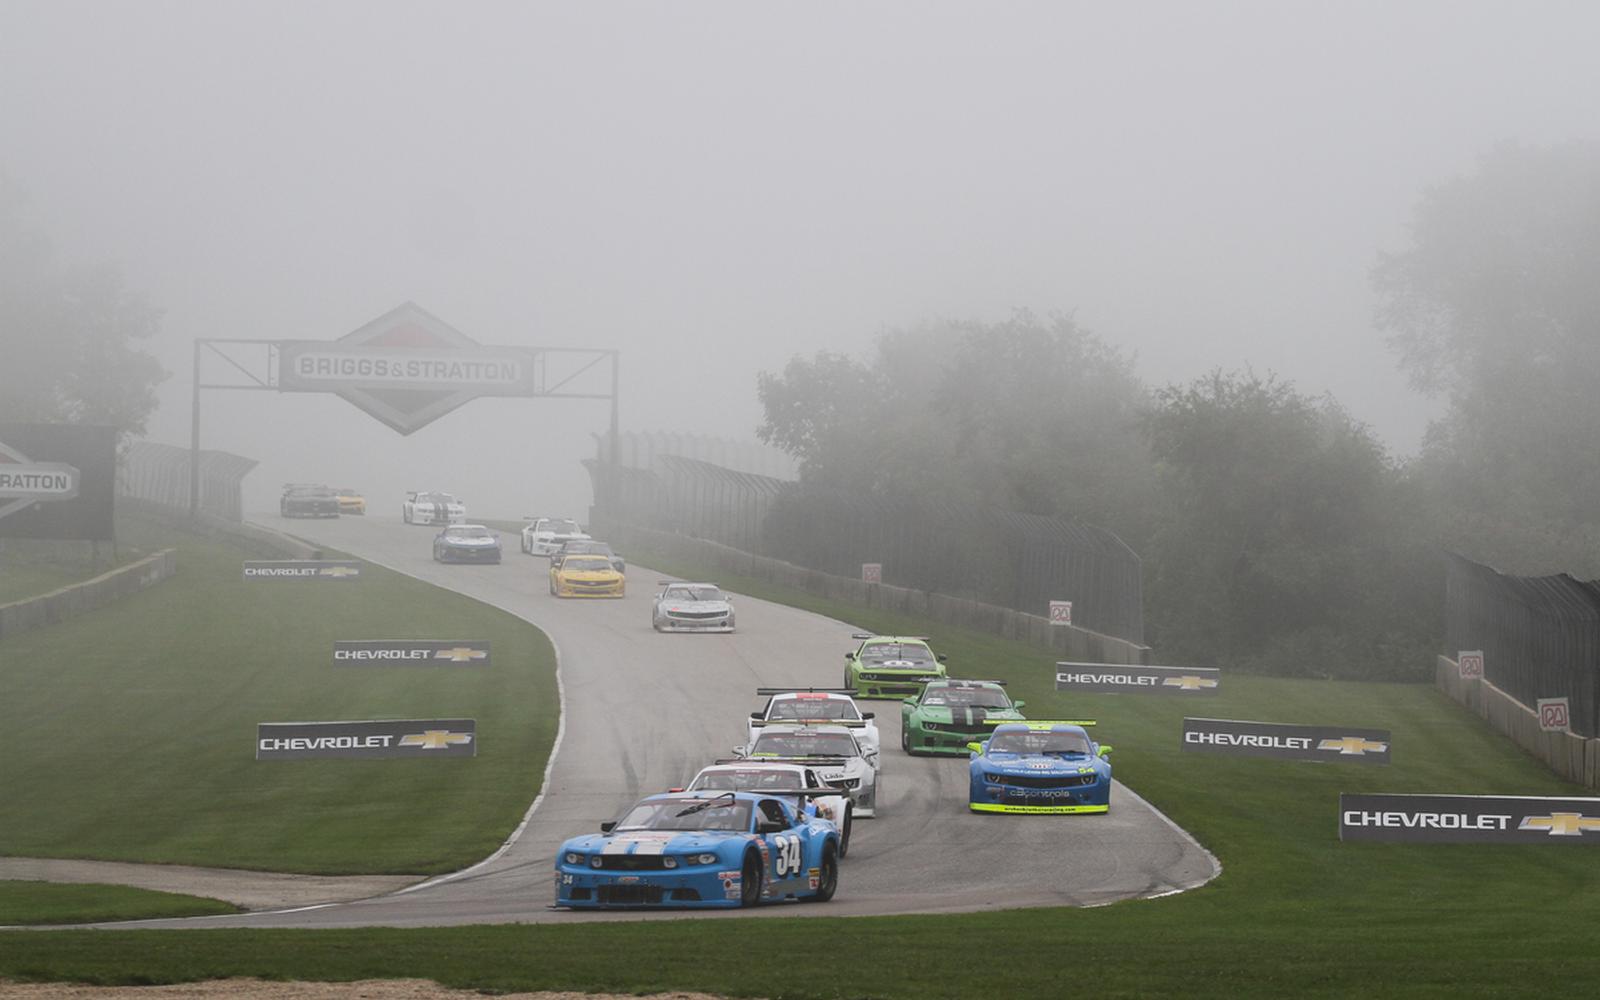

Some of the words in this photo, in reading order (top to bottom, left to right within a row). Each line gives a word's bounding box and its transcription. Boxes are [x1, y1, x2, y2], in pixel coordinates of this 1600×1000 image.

[245, 568, 317, 576] CHEVROLET
[335, 649, 430, 659] CHEVROLET
[1056, 672, 1158, 687] CHEVROLET
[260, 735, 393, 750] CHEVROLET
[1185, 732, 1312, 750] CHEVROLET
[1344, 811, 1512, 830] CHEVROLET
[775, 834, 802, 877] 34
[562, 874, 574, 885] 34
